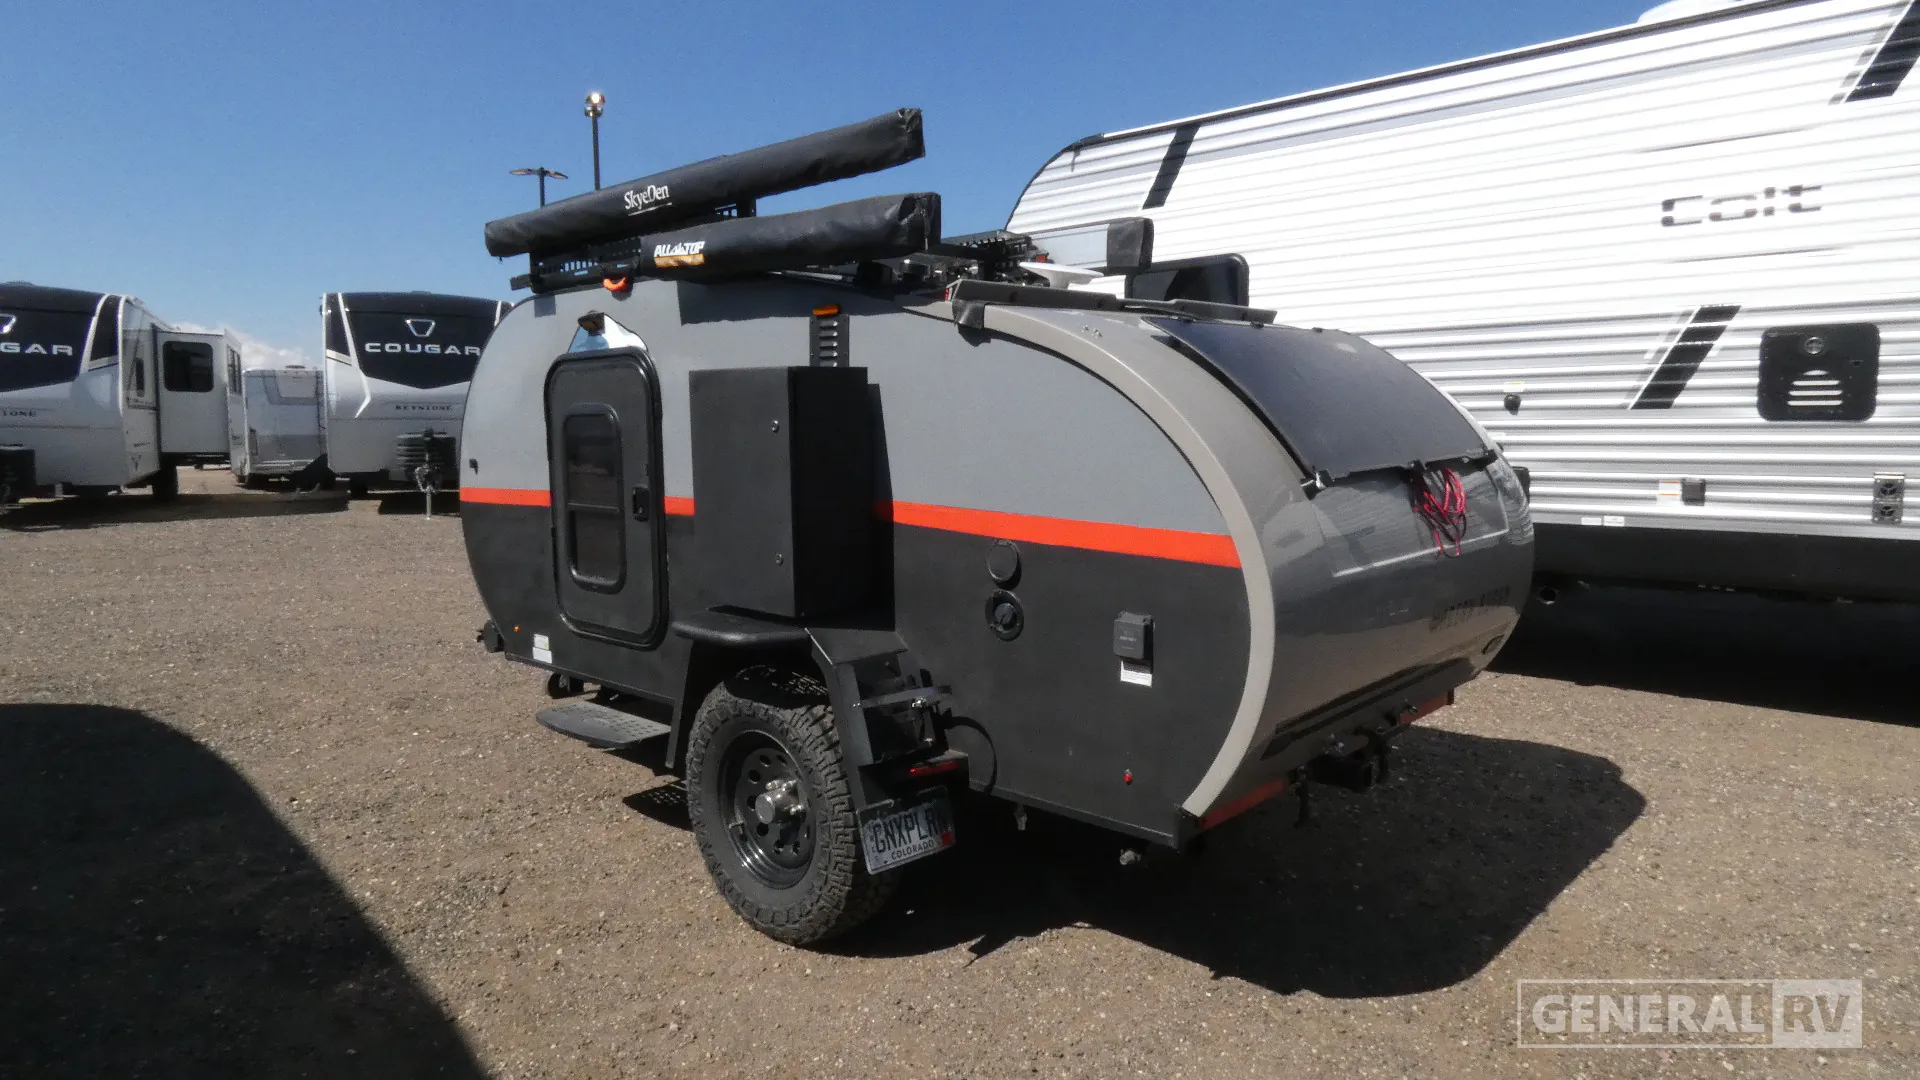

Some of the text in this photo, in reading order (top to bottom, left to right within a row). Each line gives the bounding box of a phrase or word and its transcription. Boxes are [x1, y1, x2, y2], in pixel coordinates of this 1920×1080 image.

[624, 185, 670, 210] SkyeDen
[1661, 184, 1822, 227] Colt
[365, 342, 482, 357] COUGAR
[891, 839, 934, 859] COLORADO
